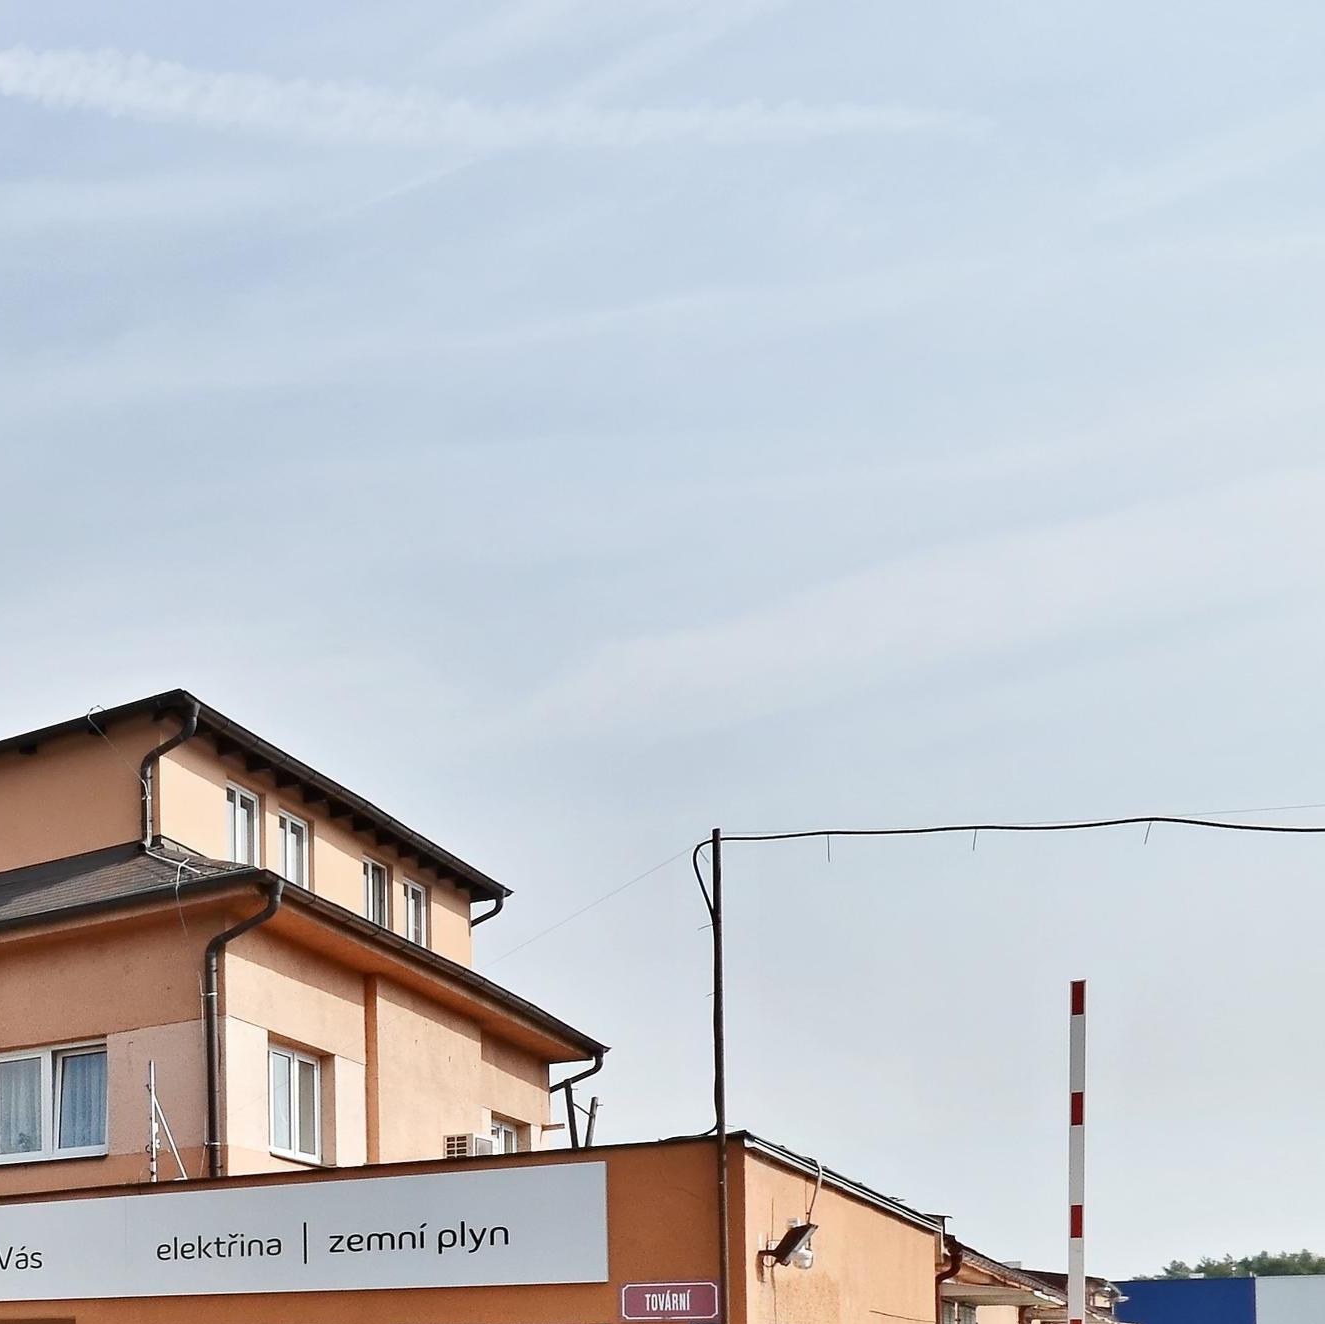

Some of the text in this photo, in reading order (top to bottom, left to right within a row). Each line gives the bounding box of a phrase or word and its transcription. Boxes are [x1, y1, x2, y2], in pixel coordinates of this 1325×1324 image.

[156, 1233, 282, 1261] elektřina
[328, 1220, 510, 1255] zemní plyn
[644, 1288, 691, 1312] TOVÁRNÍ
